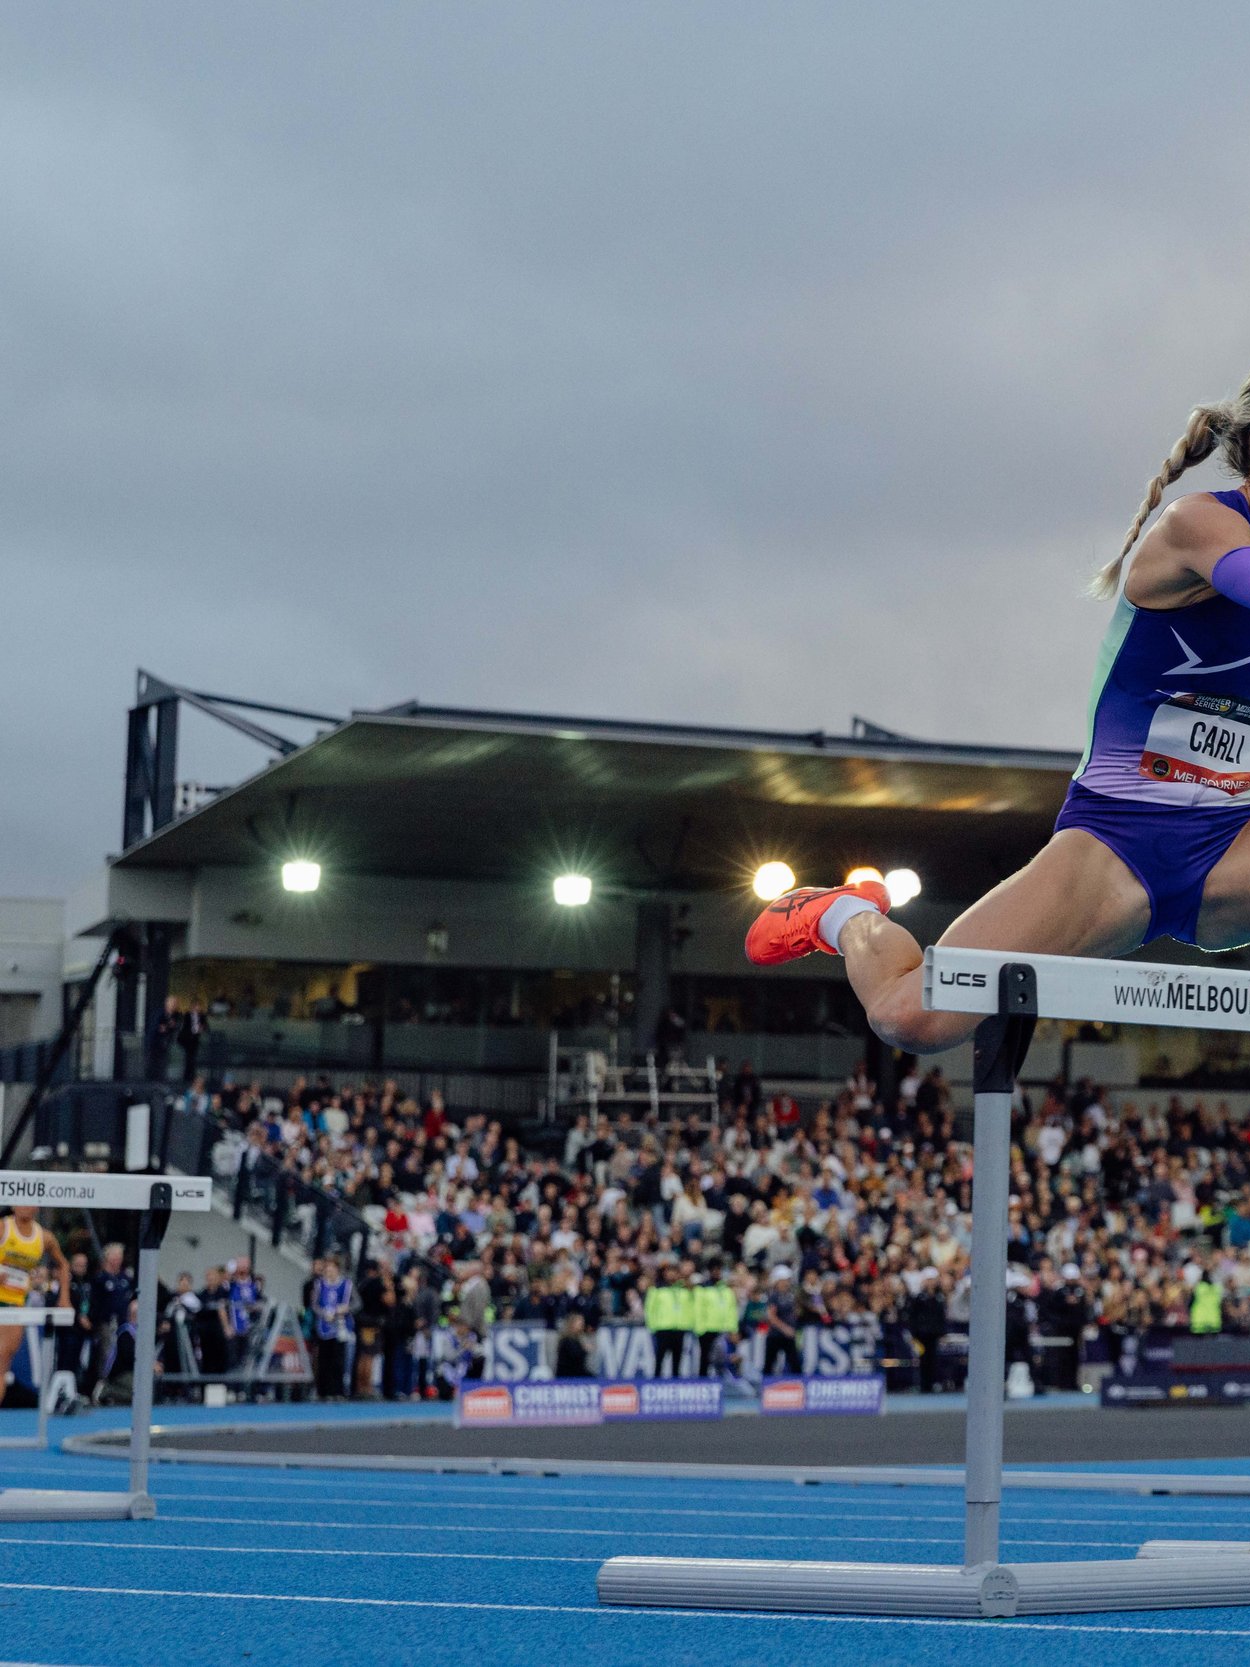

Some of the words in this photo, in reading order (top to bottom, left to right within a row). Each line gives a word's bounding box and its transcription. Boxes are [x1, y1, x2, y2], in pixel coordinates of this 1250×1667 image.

[1193, 700, 1220, 712] SERIES
[1189, 721, 1245, 765] CARLI
[940, 971, 987, 988] UCS
[175, 1189, 205, 1198] UCS
